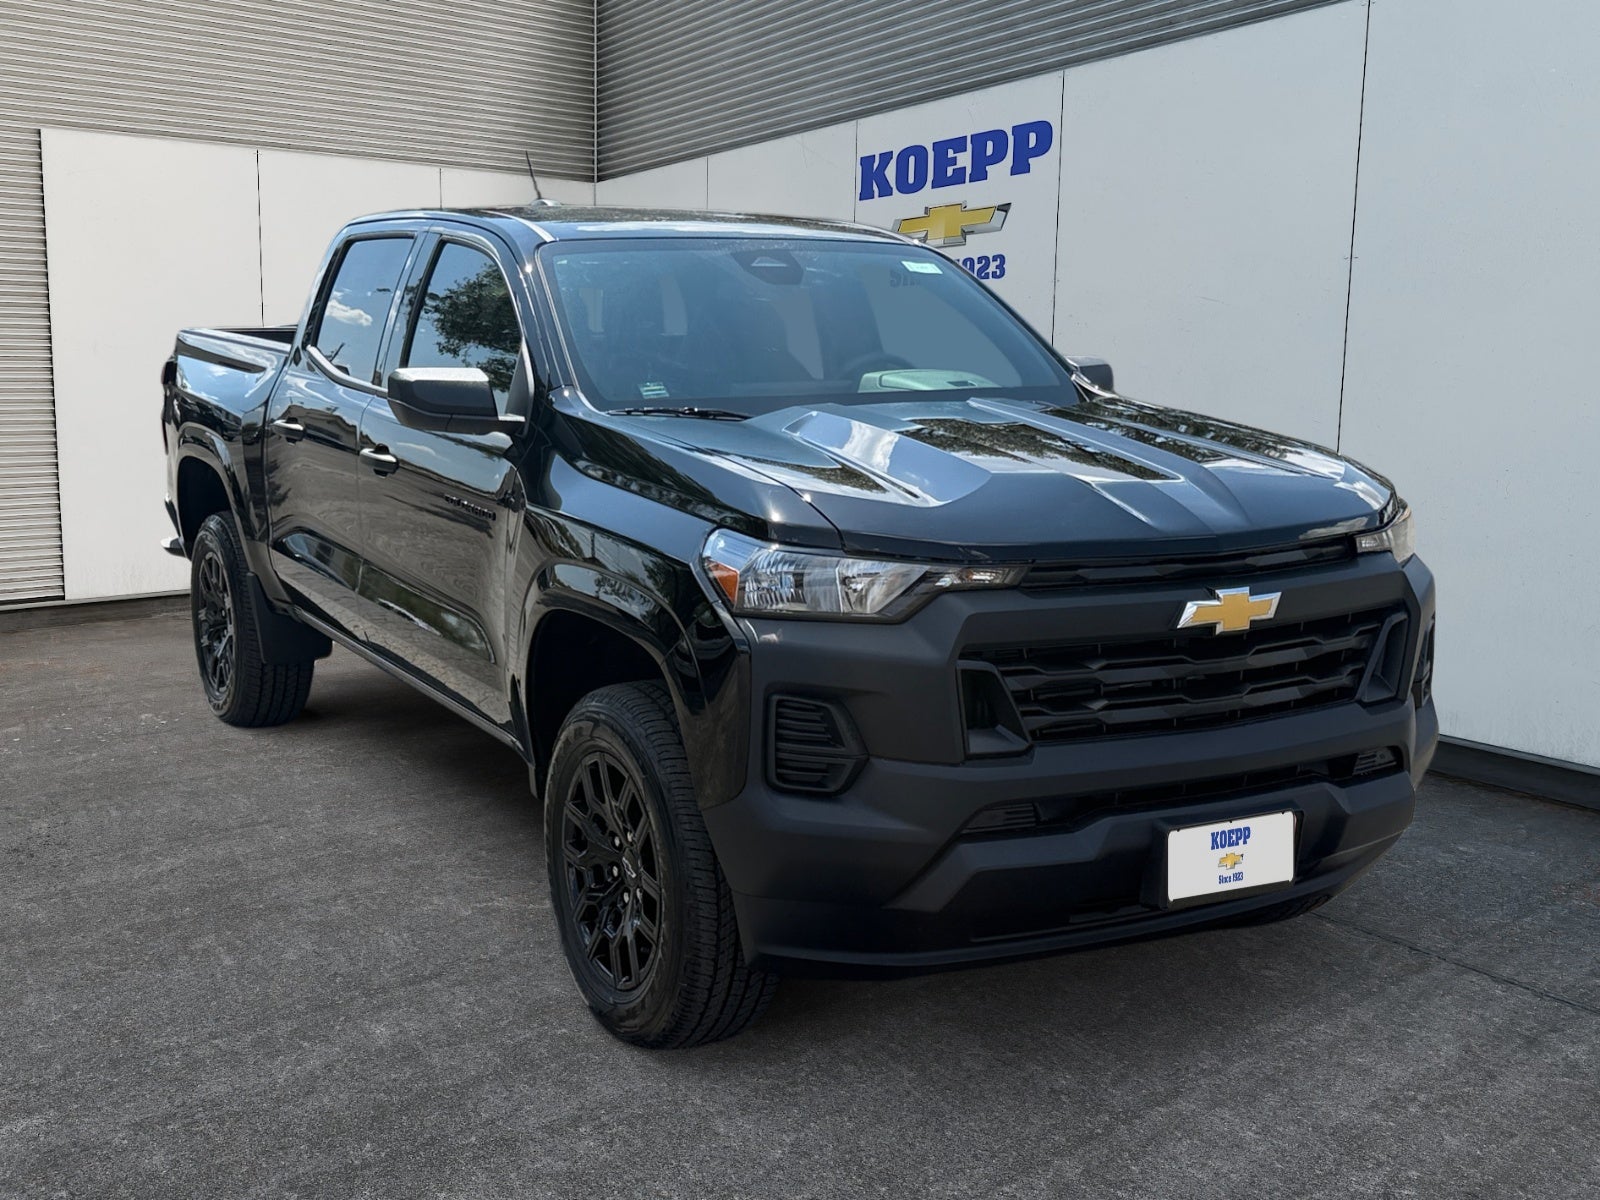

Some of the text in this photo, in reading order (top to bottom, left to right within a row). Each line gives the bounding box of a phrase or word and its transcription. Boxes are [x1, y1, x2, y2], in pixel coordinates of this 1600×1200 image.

[859, 120, 1053, 201] KOEPP
[955, 254, 1006, 280] 923
[1210, 826, 1251, 850] KOEPP
